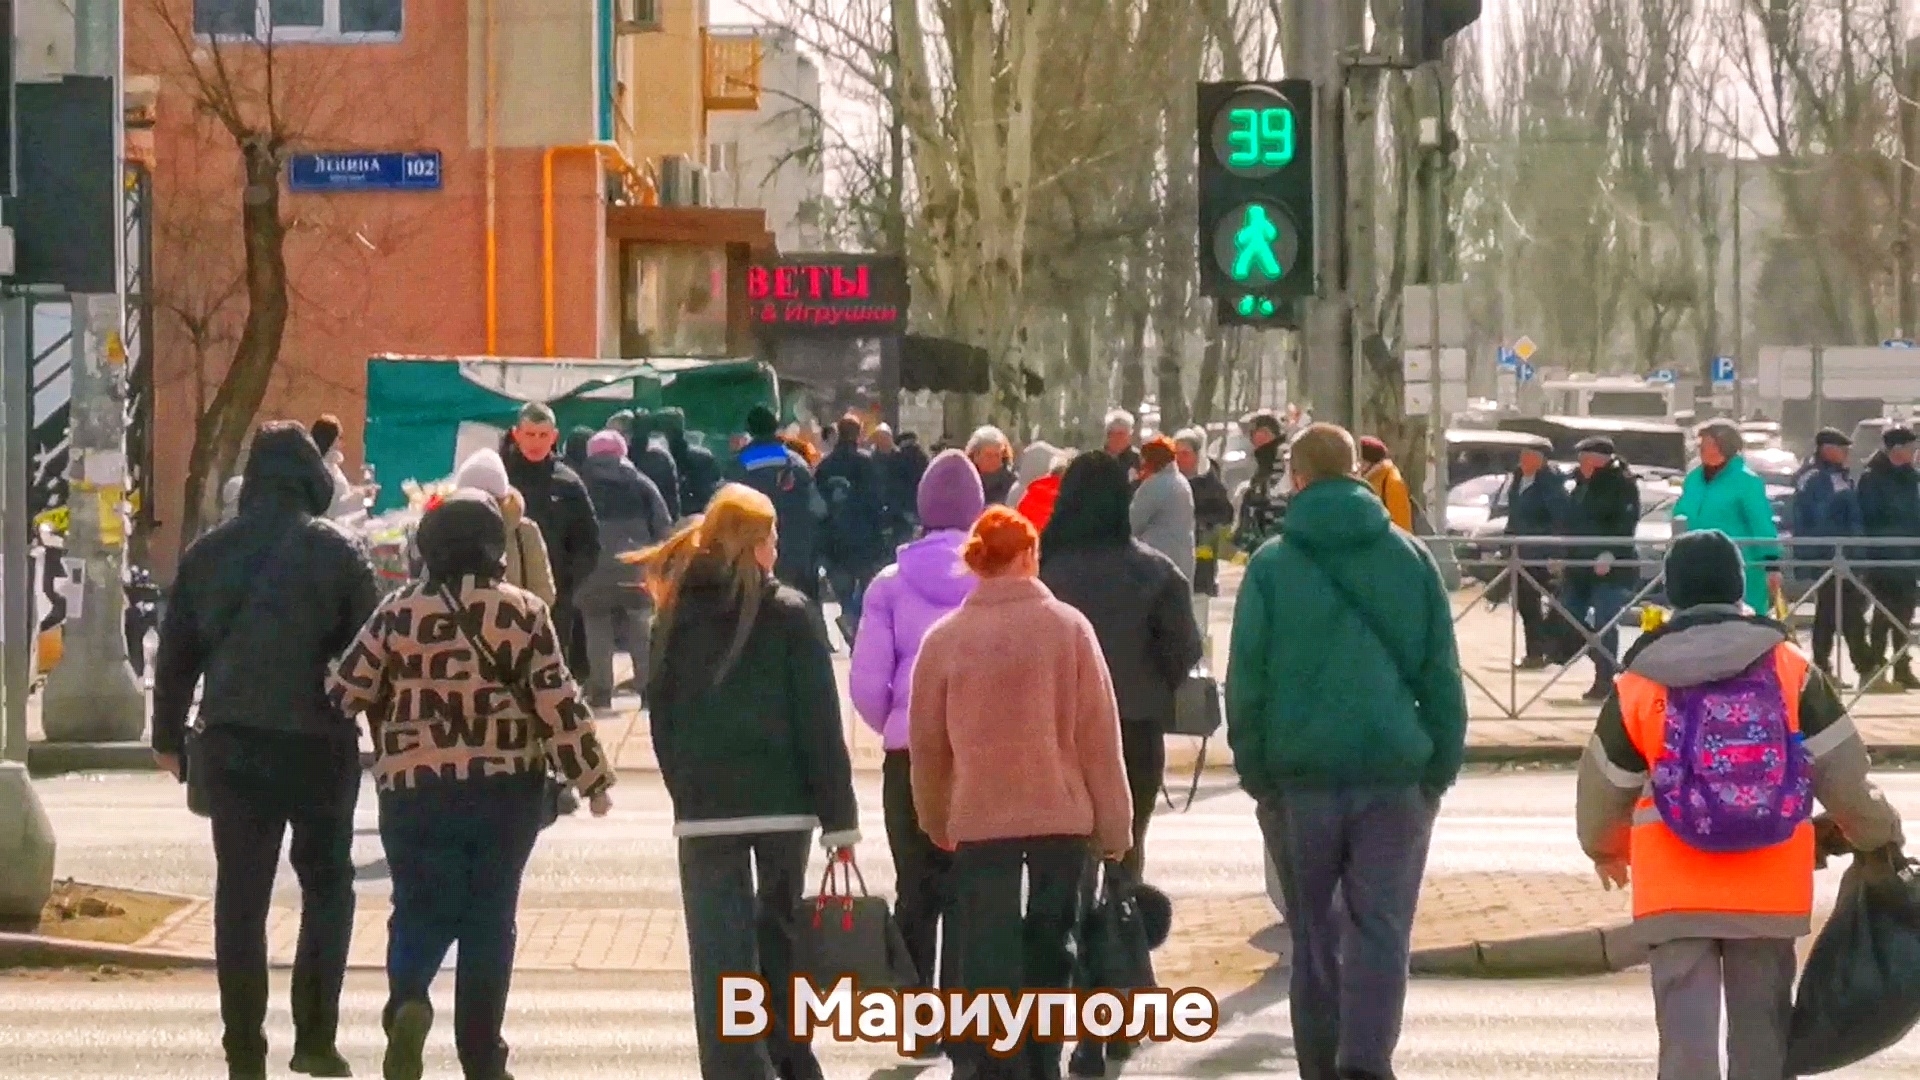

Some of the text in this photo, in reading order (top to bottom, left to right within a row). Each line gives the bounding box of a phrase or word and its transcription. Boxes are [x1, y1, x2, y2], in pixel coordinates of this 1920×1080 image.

[1230, 108, 1292, 163] 39
[407, 159, 434, 177] 102
[748, 265, 870, 299] ВЕТЫ
